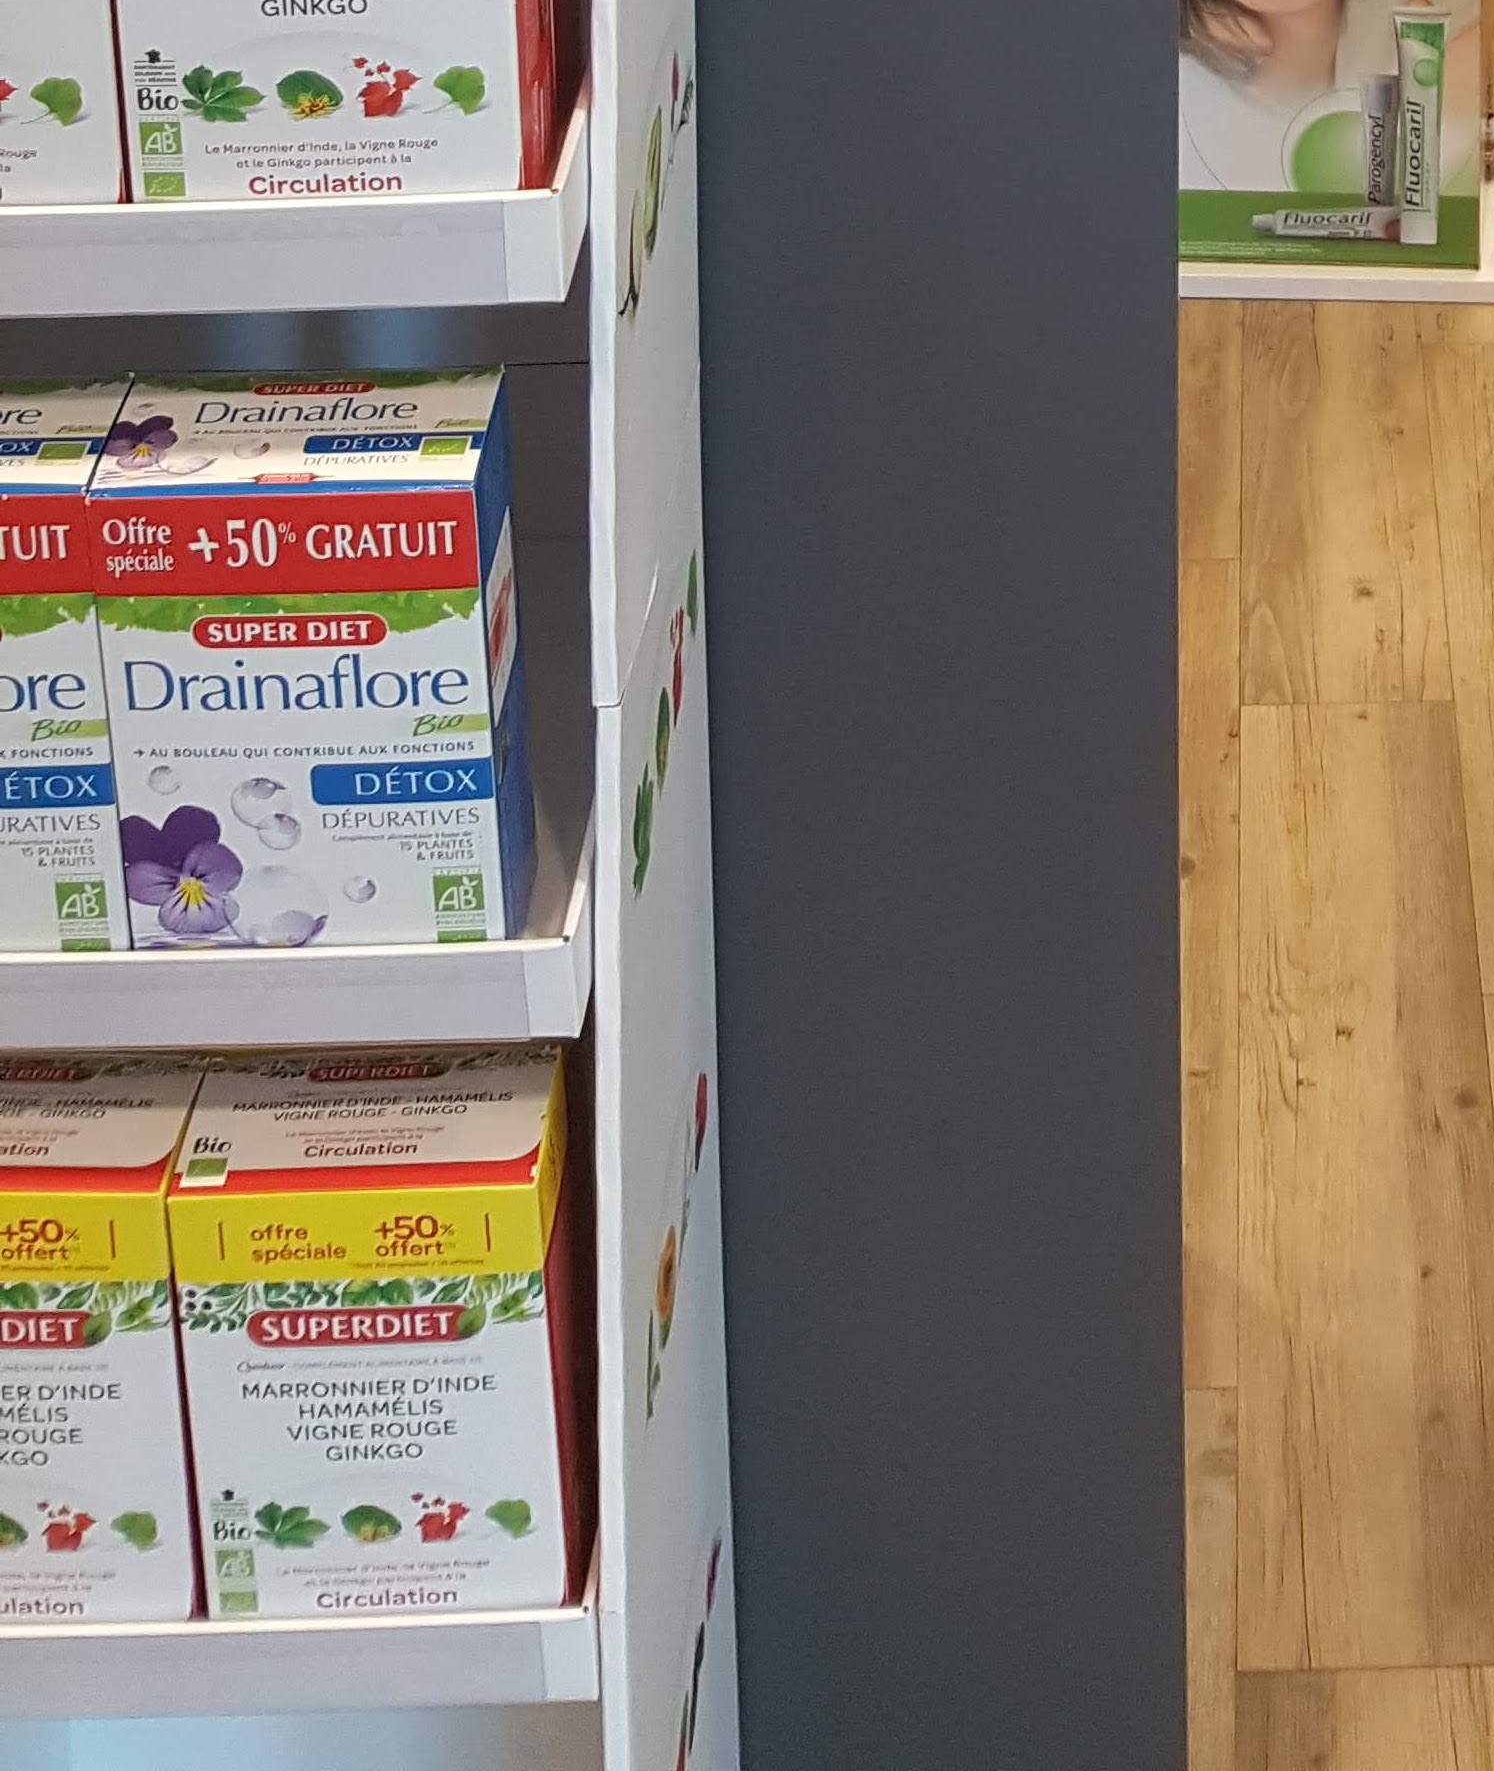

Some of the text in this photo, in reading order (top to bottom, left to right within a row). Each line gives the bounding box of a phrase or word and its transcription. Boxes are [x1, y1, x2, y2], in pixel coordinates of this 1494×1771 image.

[138, 88, 179, 111] Bio
[144, 131, 177, 153] AB
[205, 144, 219, 154] Le
[223, 143, 294, 154] Marronnier
[345, 140, 356, 150] la
[360, 139, 395, 152] Vigne
[398, 138, 438, 151] Rouge
[253, 158, 263, 168] le
[267, 157, 311, 171] Ginkgo
[315, 155, 387, 169] participent
[401, 153, 412, 163] la
[1368, 113, 1385, 205] Parogencyl
[1405, 100, 1422, 207] Fluocaril
[249, 173, 402, 195] Circulation
[1284, 211, 1374, 225] Fluocaril
[263, 383, 365, 394] SUPER DIET
[195, 398, 418, 424] Drainaflore
[332, 433, 413, 451] DÉTOX
[303, 454, 408, 467] DÉPURATIVES
[102, 516, 458, 568] Offre +50% GRATUIT
[106, 548, 175, 578] spéciale
[208, 620, 373, 643] SUPER DIET
[123, 654, 470, 712] Drainaflore
[31, 719, 82, 742] Bio
[412, 713, 464, 737] Bio
[11, 746, 94, 758] FONCTIONS
[149, 741, 475, 758] AU BOULEAU QUI CONTRIBUE AUX FONCTIONS
[354, 765, 478, 796] DÉTOX
[322, 807, 481, 830] DÉPURATIVES
[38, 845, 95, 857] PLANTES
[417, 838, 474, 850] PLANTES
[430, 850, 475, 860] FRUITS
[52, 856, 95, 867] FRUITS
[61, 893, 101, 918] AB
[438, 885, 477, 910] AB
[273, 1105, 468, 1122] VIGNE ROUGE GINKGO
[192, 1137, 233, 1155] Bio
[304, 1142, 418, 1158] Circulation
[250, 1215, 455, 1242] offre +50%
[252, 1245, 347, 1266] spéciale
[261, 1312, 454, 1342] SUPERDIET
[38, 1383, 121, 1400] D'INDE
[242, 1375, 497, 1400] MARRONNIER D'INDE
[299, 1397, 444, 1420] HAMAMÉLIS
[287, 1420, 458, 1442] VIGNE ROUGE
[326, 1443, 423, 1461] GINKGO
[213, 1521, 251, 1542] Bio
[317, 1587, 458, 1609] Circulation
